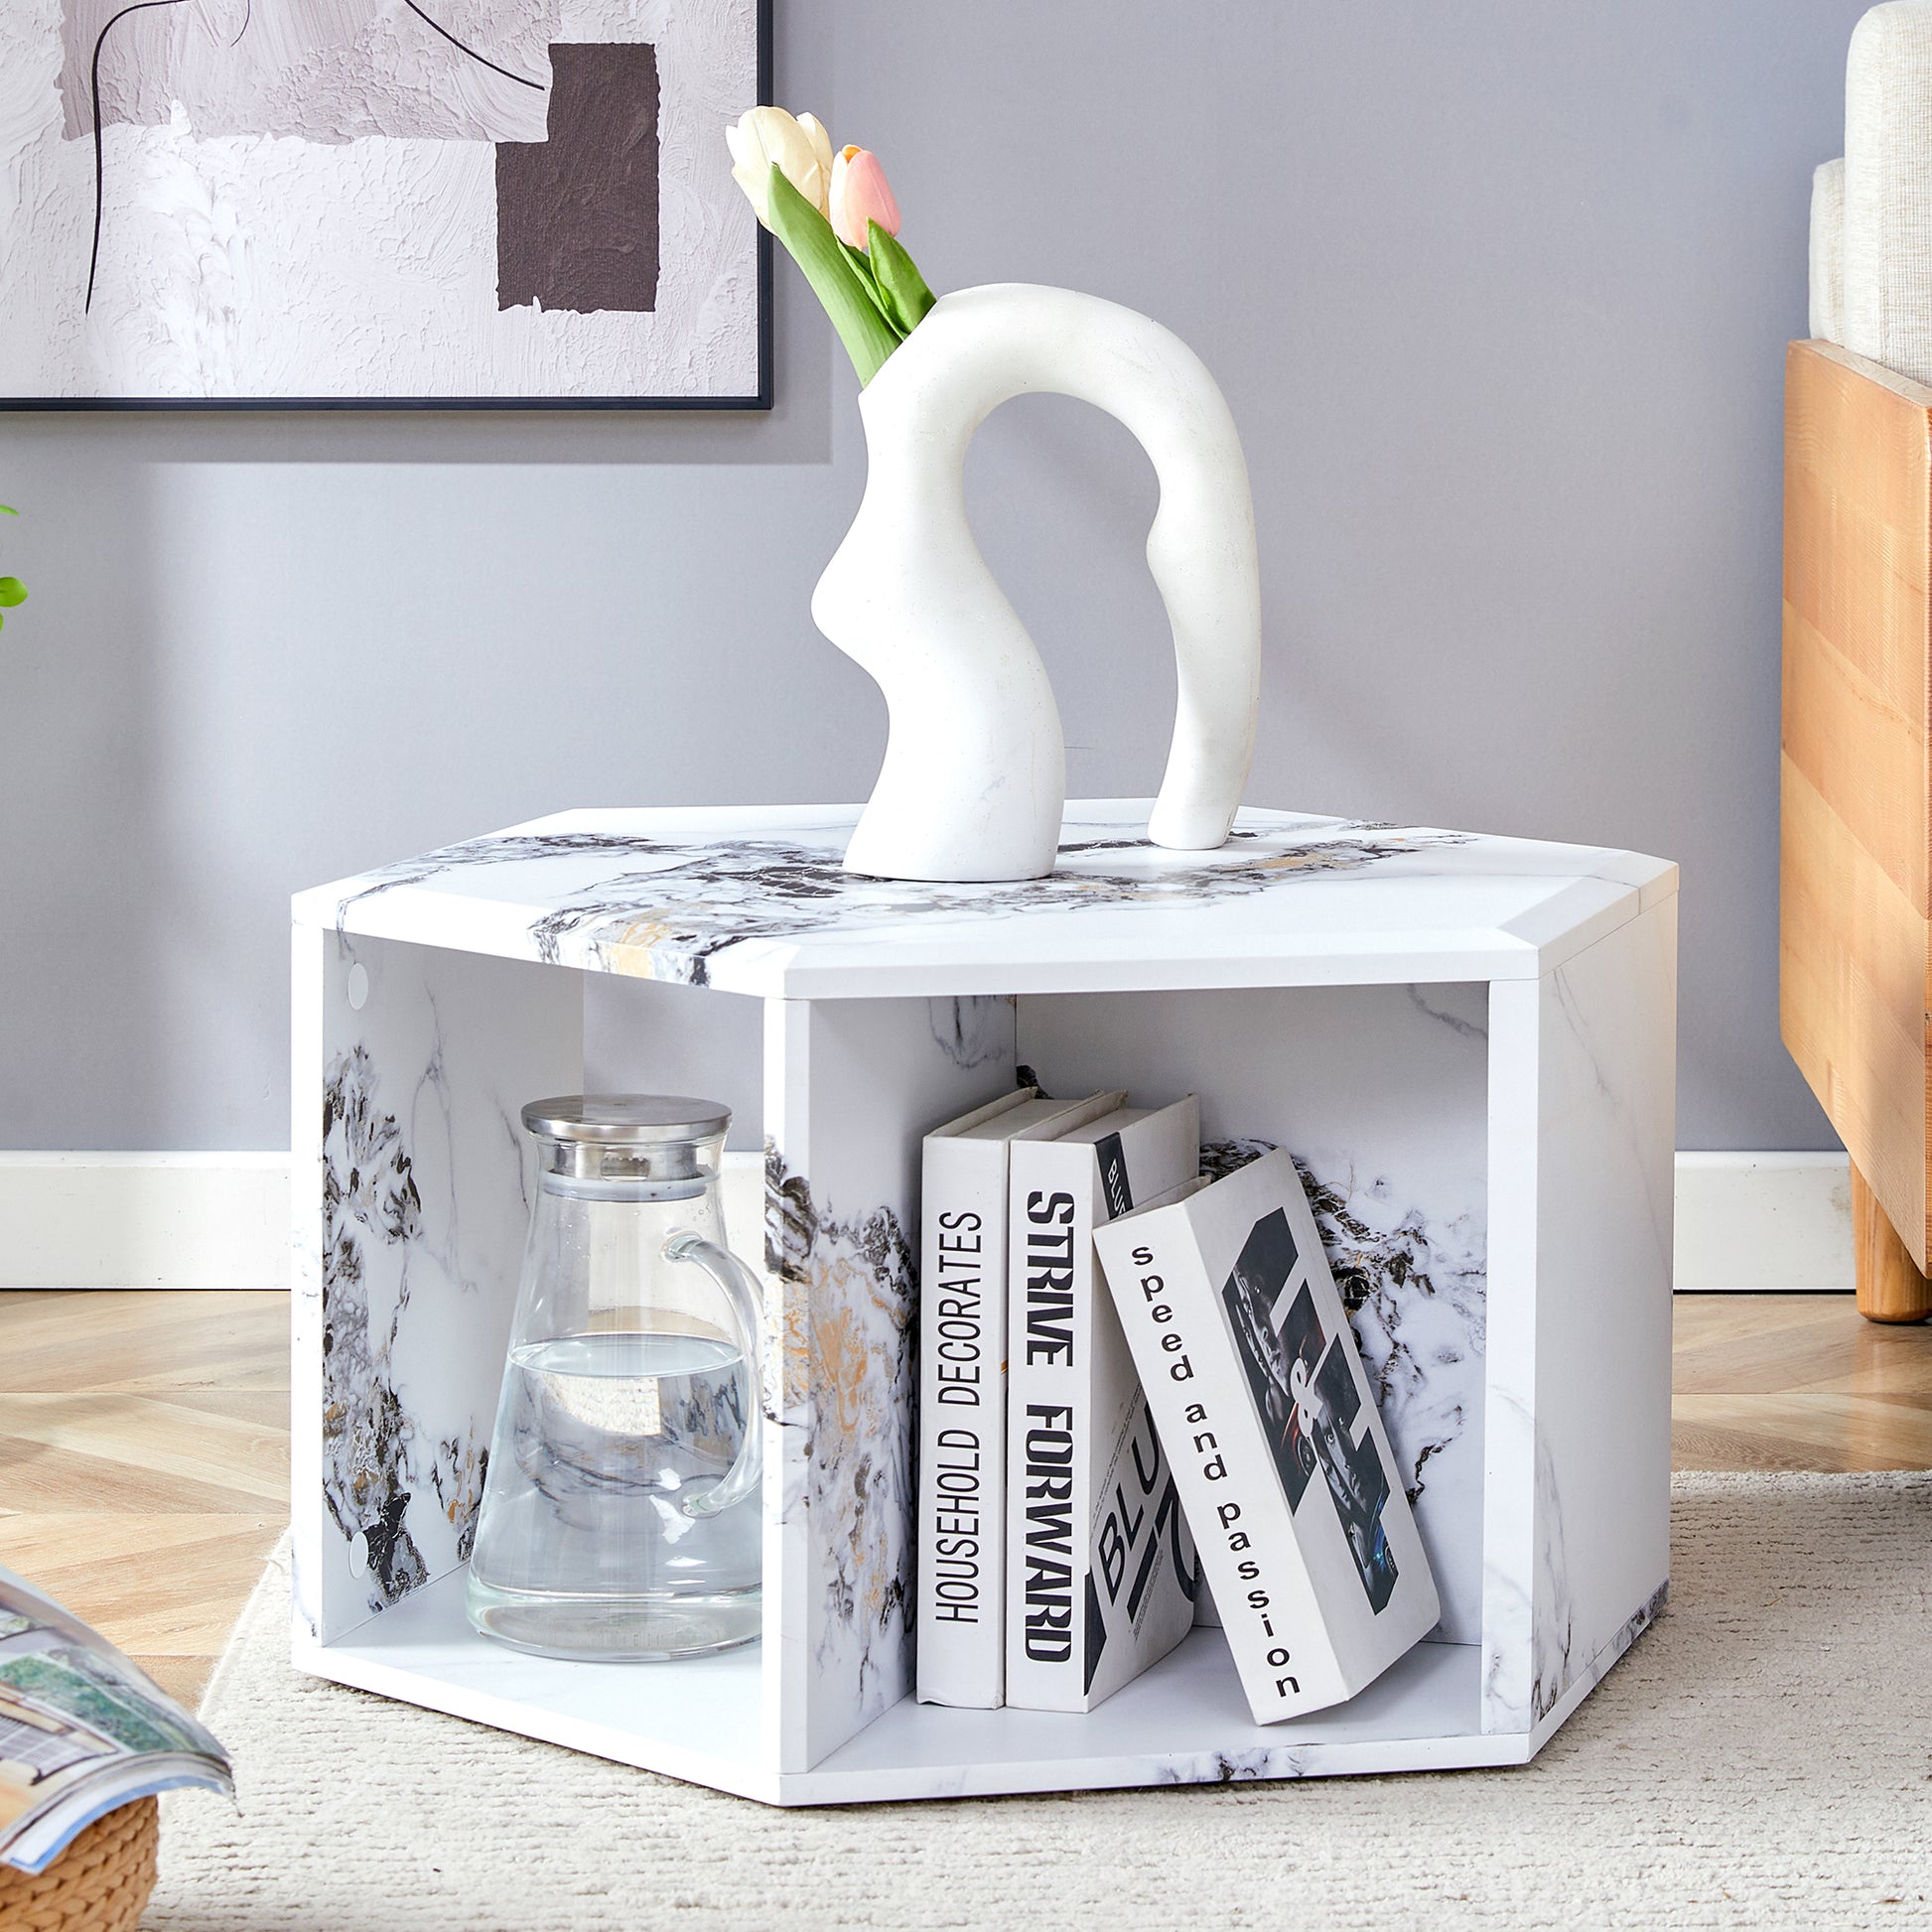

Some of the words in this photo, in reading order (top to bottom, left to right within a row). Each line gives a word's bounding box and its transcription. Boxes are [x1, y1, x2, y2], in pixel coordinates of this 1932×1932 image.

[937, 1211, 982, 1407] DECORATES
[1026, 1190, 1075, 1367] STRIVE
[935, 1429, 980, 1623] HOUSEHOLD
[1025, 1404, 1073, 1663] FORWARD
[1131, 1246, 1194, 1382] speed
[1184, 1403, 1228, 1481] and
[1216, 1502, 1301, 1698] passion
